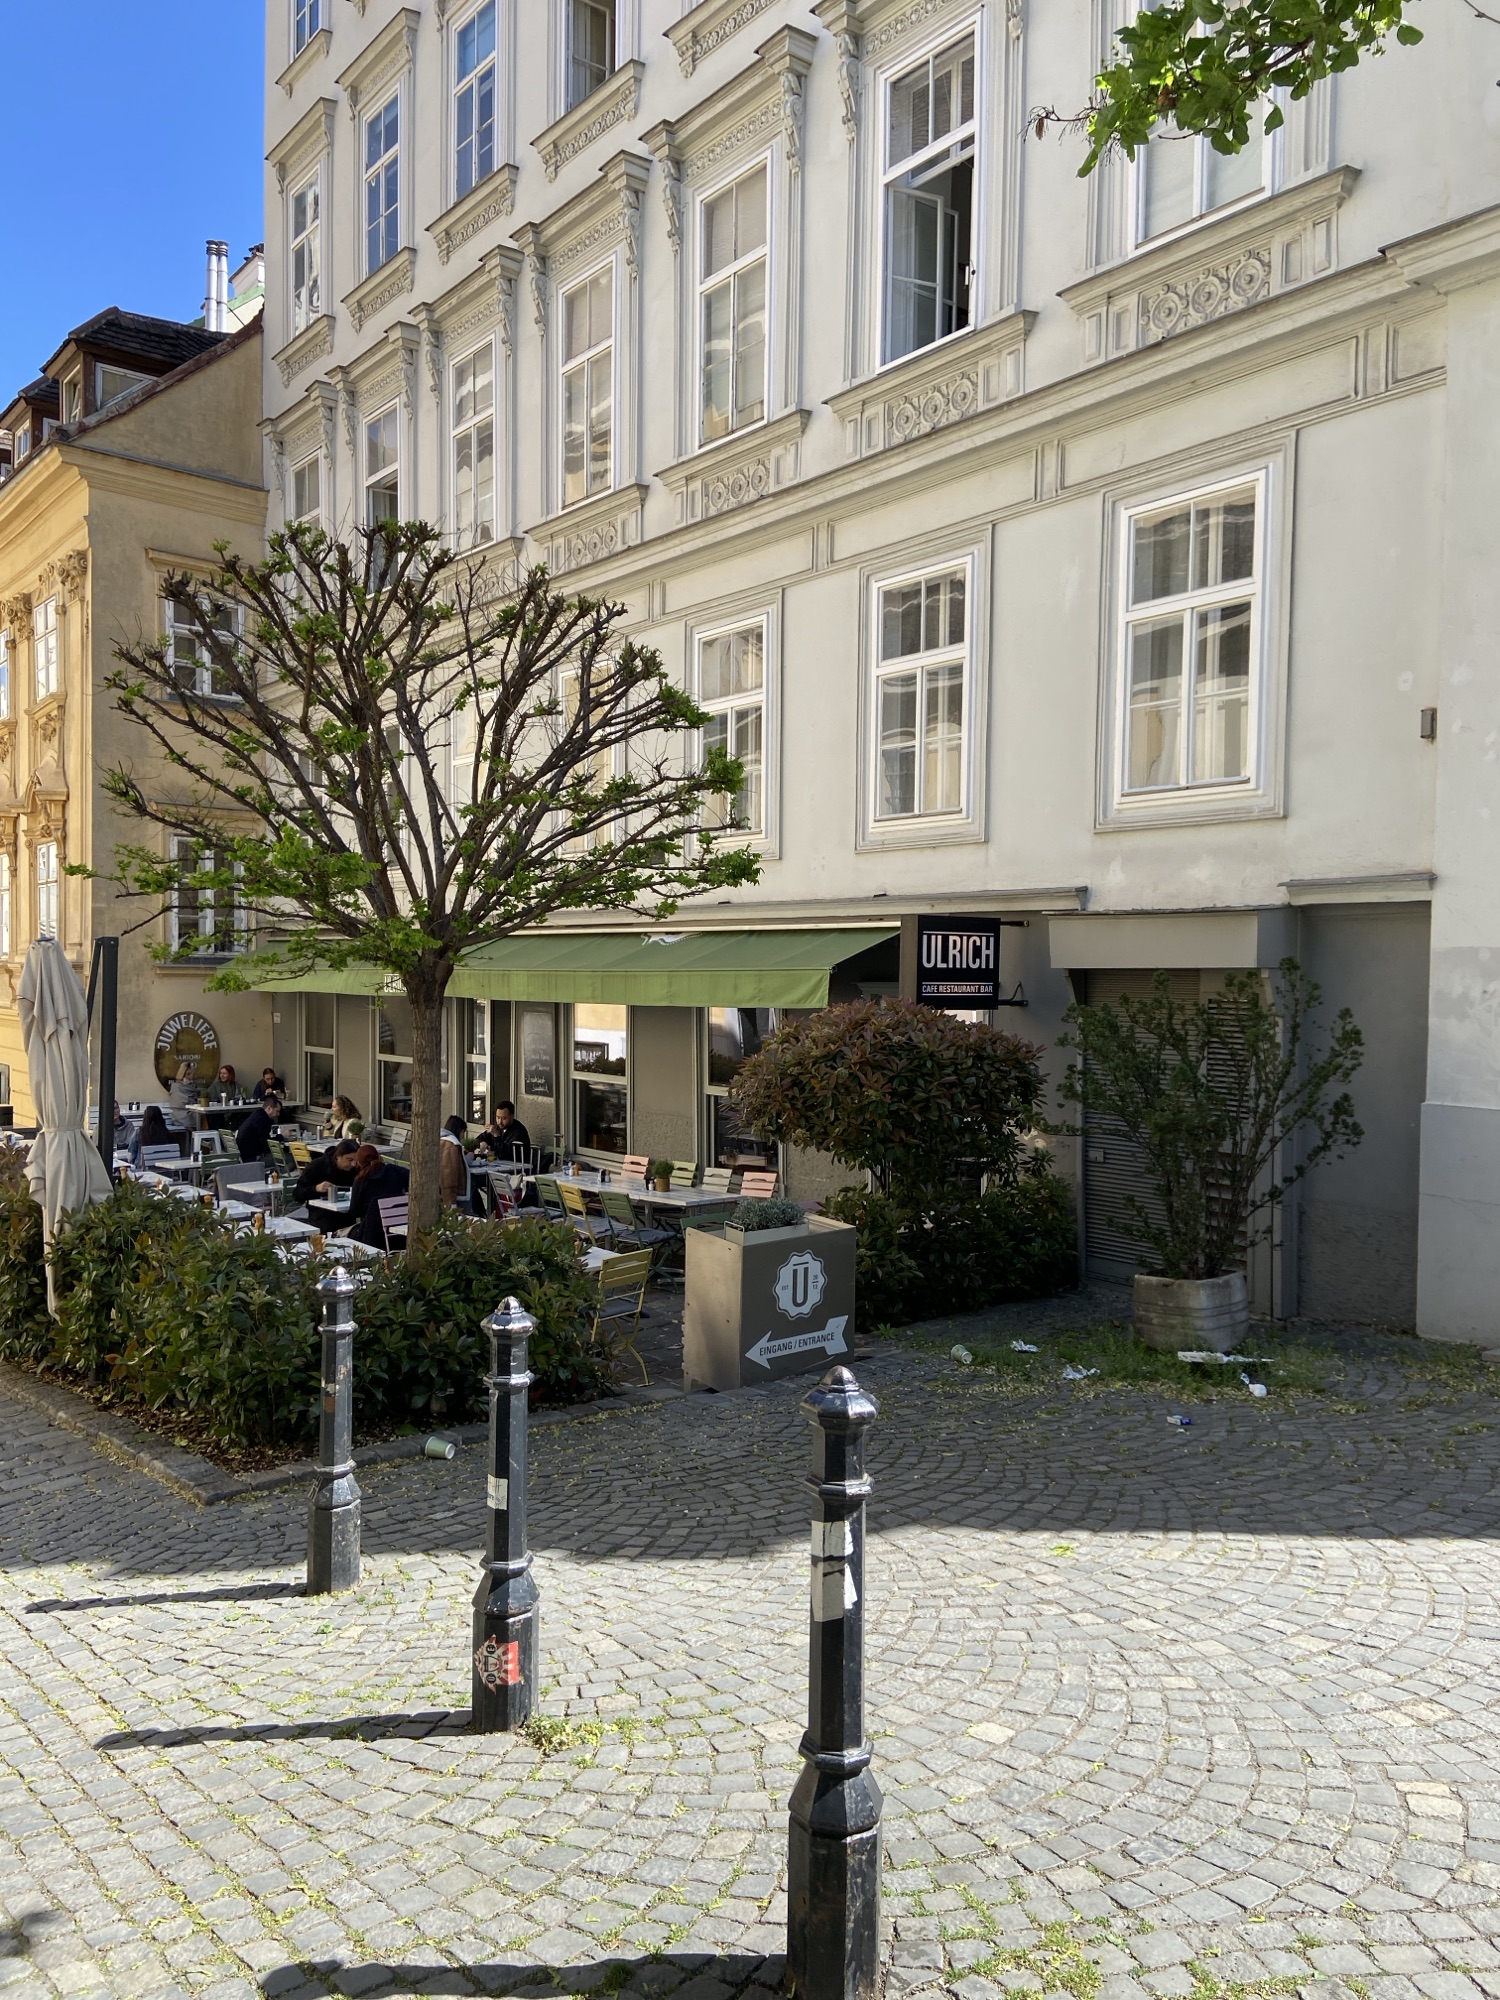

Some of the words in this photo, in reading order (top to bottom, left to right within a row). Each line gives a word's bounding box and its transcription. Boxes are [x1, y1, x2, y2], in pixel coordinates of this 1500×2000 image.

[922, 934, 995, 969] ULRICH
[922, 985, 938, 993] CAFE
[938, 985, 979, 993] RESTAURANT
[980, 985, 993, 993] BAR
[157, 1014, 217, 1051] JUWELIERE
[759, 1341, 793, 1356] EINGANG
[798, 1332, 835, 1348] ENTRANCE
